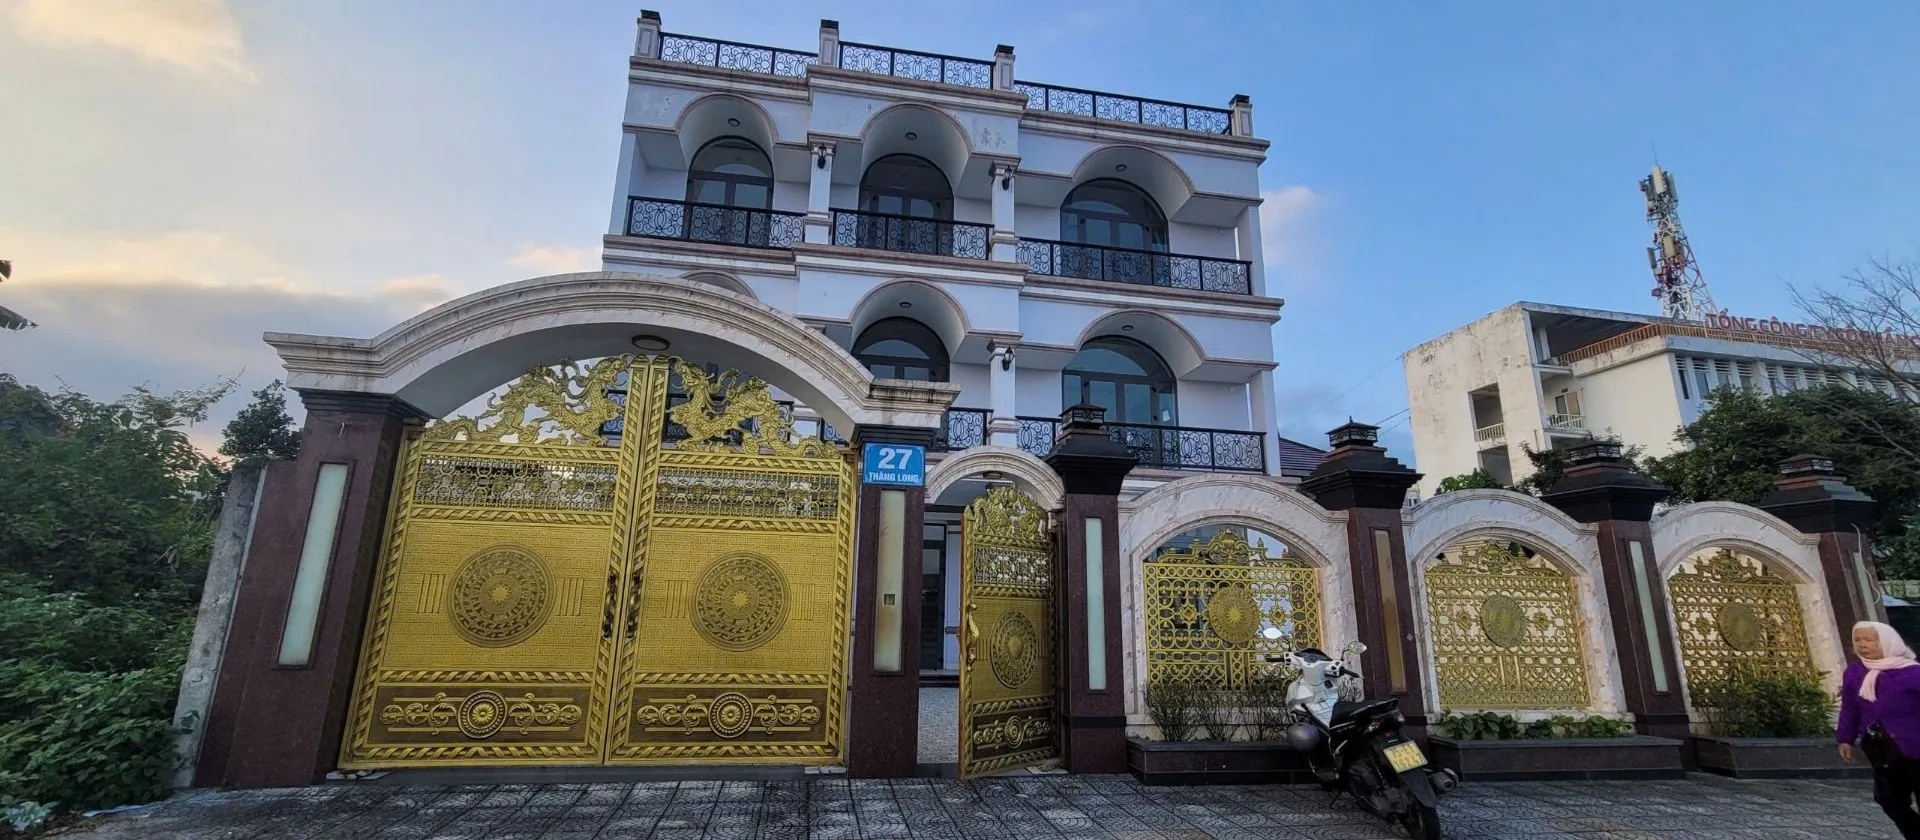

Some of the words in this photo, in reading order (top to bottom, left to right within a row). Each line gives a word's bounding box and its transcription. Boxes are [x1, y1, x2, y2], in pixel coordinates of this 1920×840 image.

[1704, 307, 1757, 332] TỔNG
[1758, 316, 1806, 338] CÔNG
[878, 447, 912, 470] 27
[868, 471, 896, 482] THĂNG
[898, 474, 919, 483] LONG
